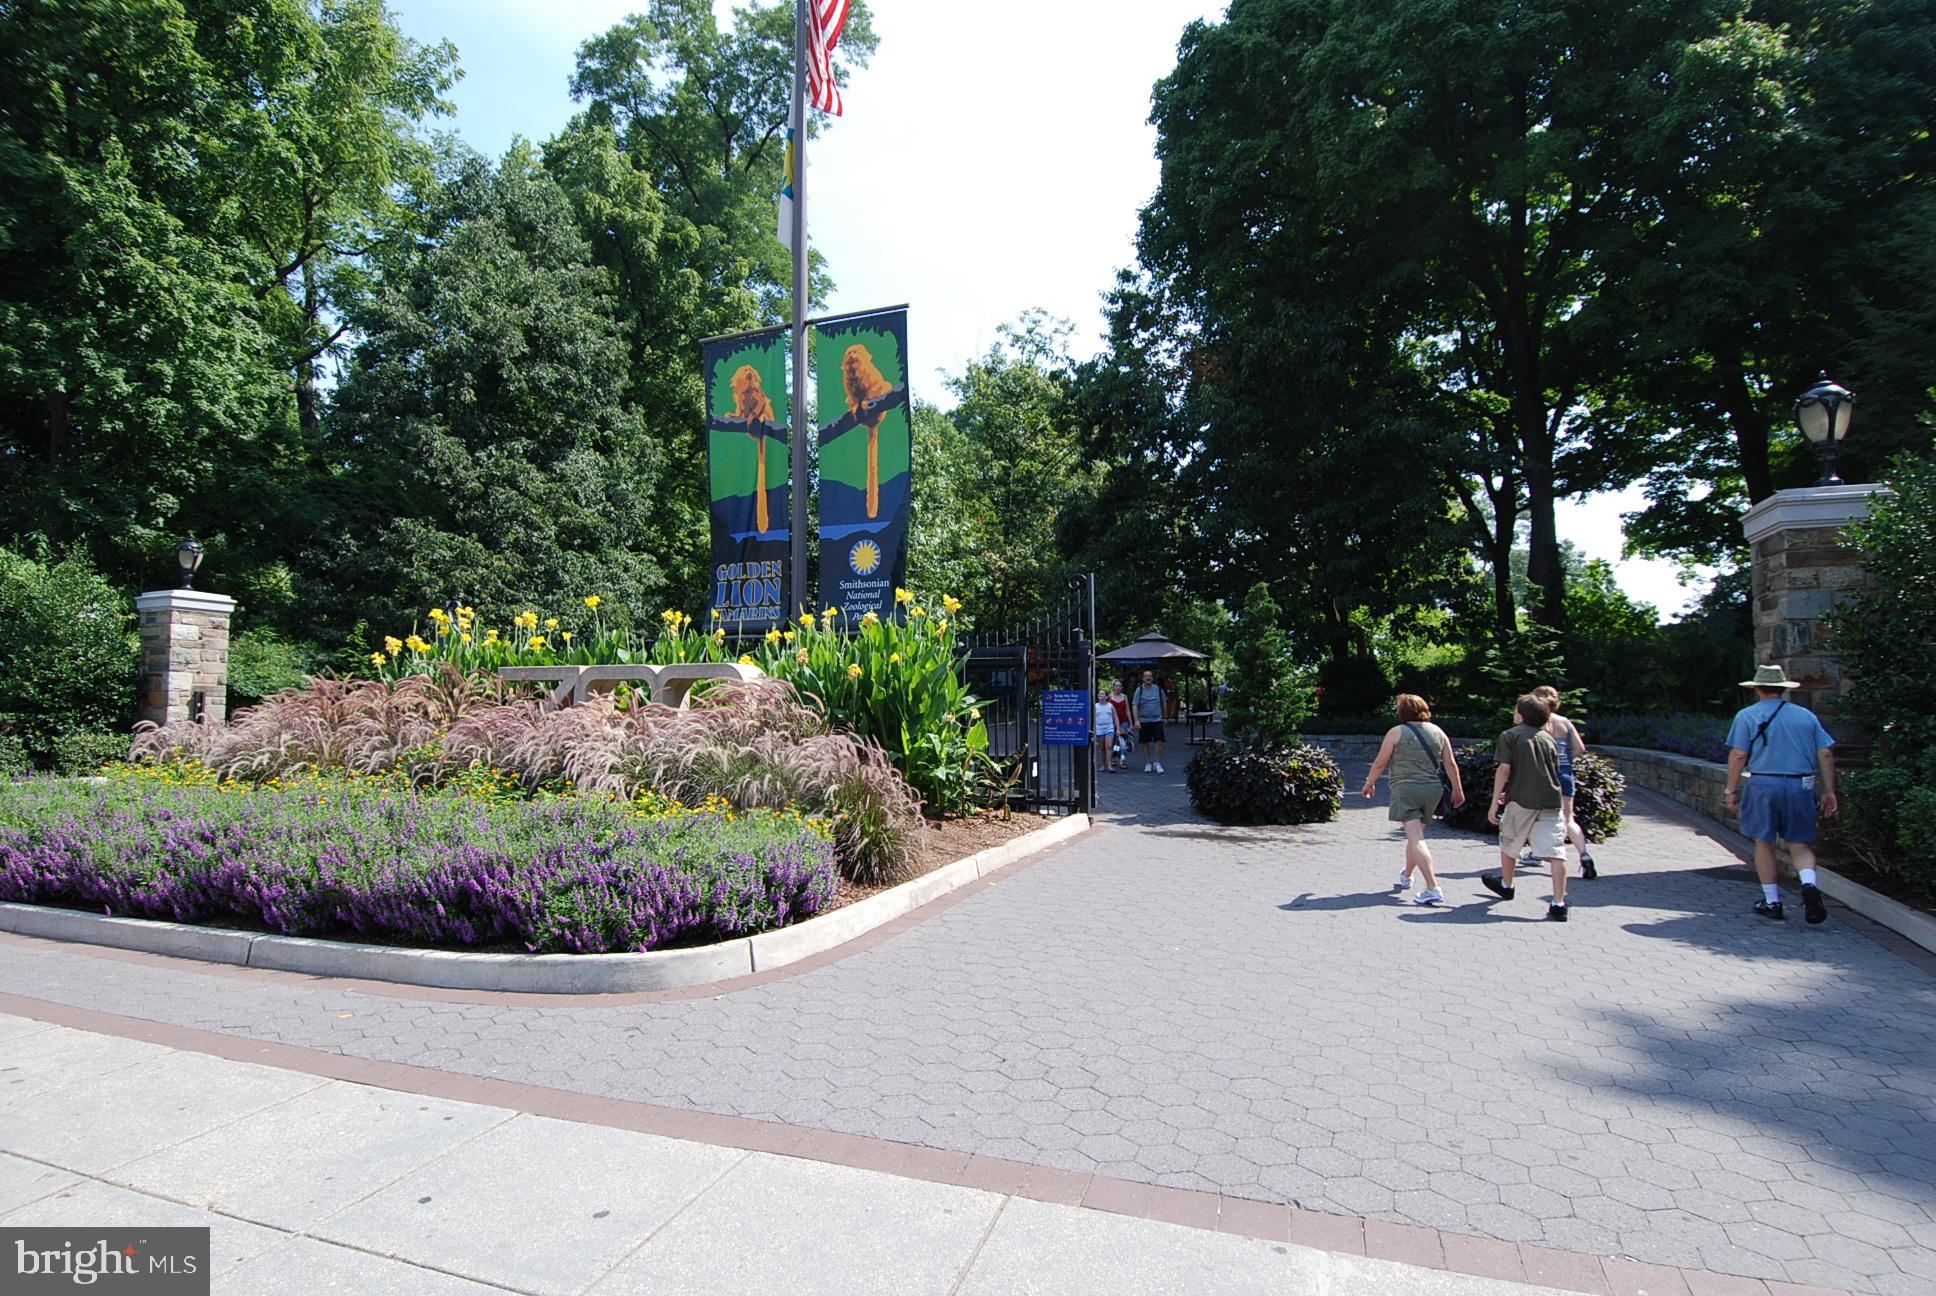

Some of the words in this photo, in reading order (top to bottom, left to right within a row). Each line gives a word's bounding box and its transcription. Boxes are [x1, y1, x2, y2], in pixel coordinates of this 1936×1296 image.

[716, 560, 782, 582] GOLDEN
[839, 578, 890, 591] Smithsonian
[714, 578, 782, 608] LION
[846, 589, 881, 601] National
[843, 599, 883, 613] Zoological
